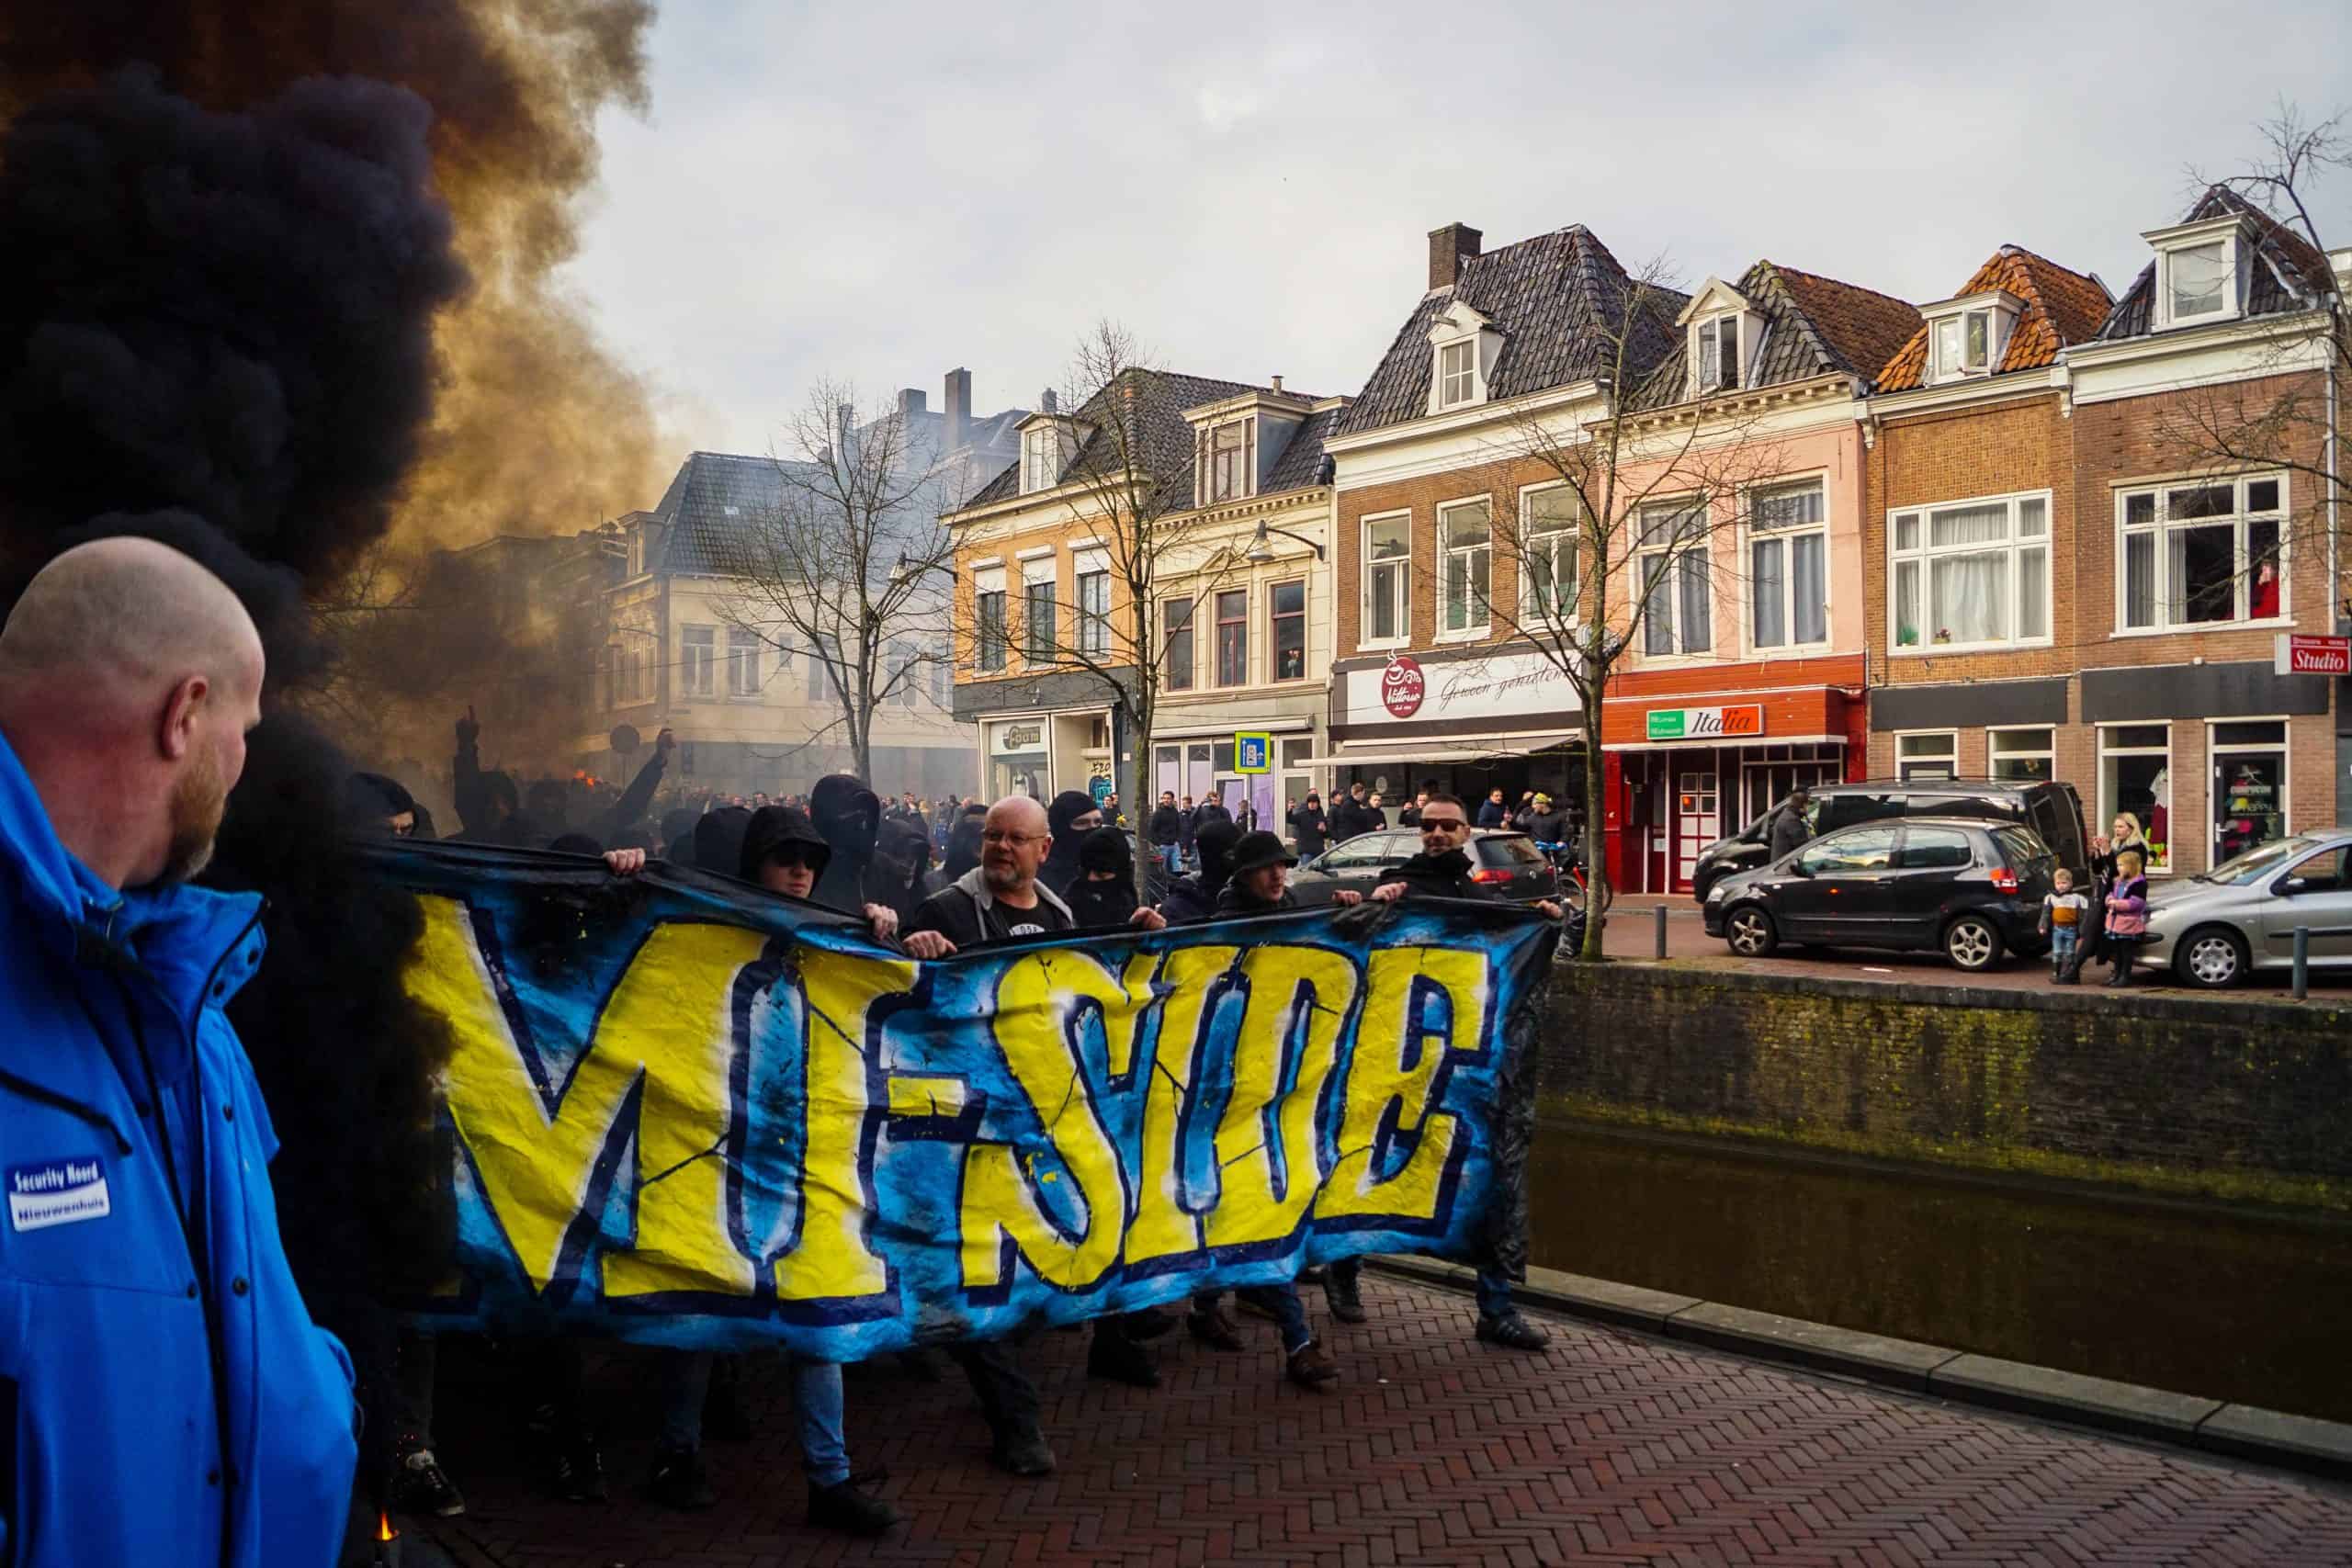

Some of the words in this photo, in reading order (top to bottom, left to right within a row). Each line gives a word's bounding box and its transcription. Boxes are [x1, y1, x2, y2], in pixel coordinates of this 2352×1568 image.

[2294, 649, 2345, 671] Studio
[1440, 675, 1493, 712] Gewoon
[1691, 710, 1750, 734] Italia
[15, 1167, 65, 1192] Security
[66, 1160, 98, 1183] Noord
